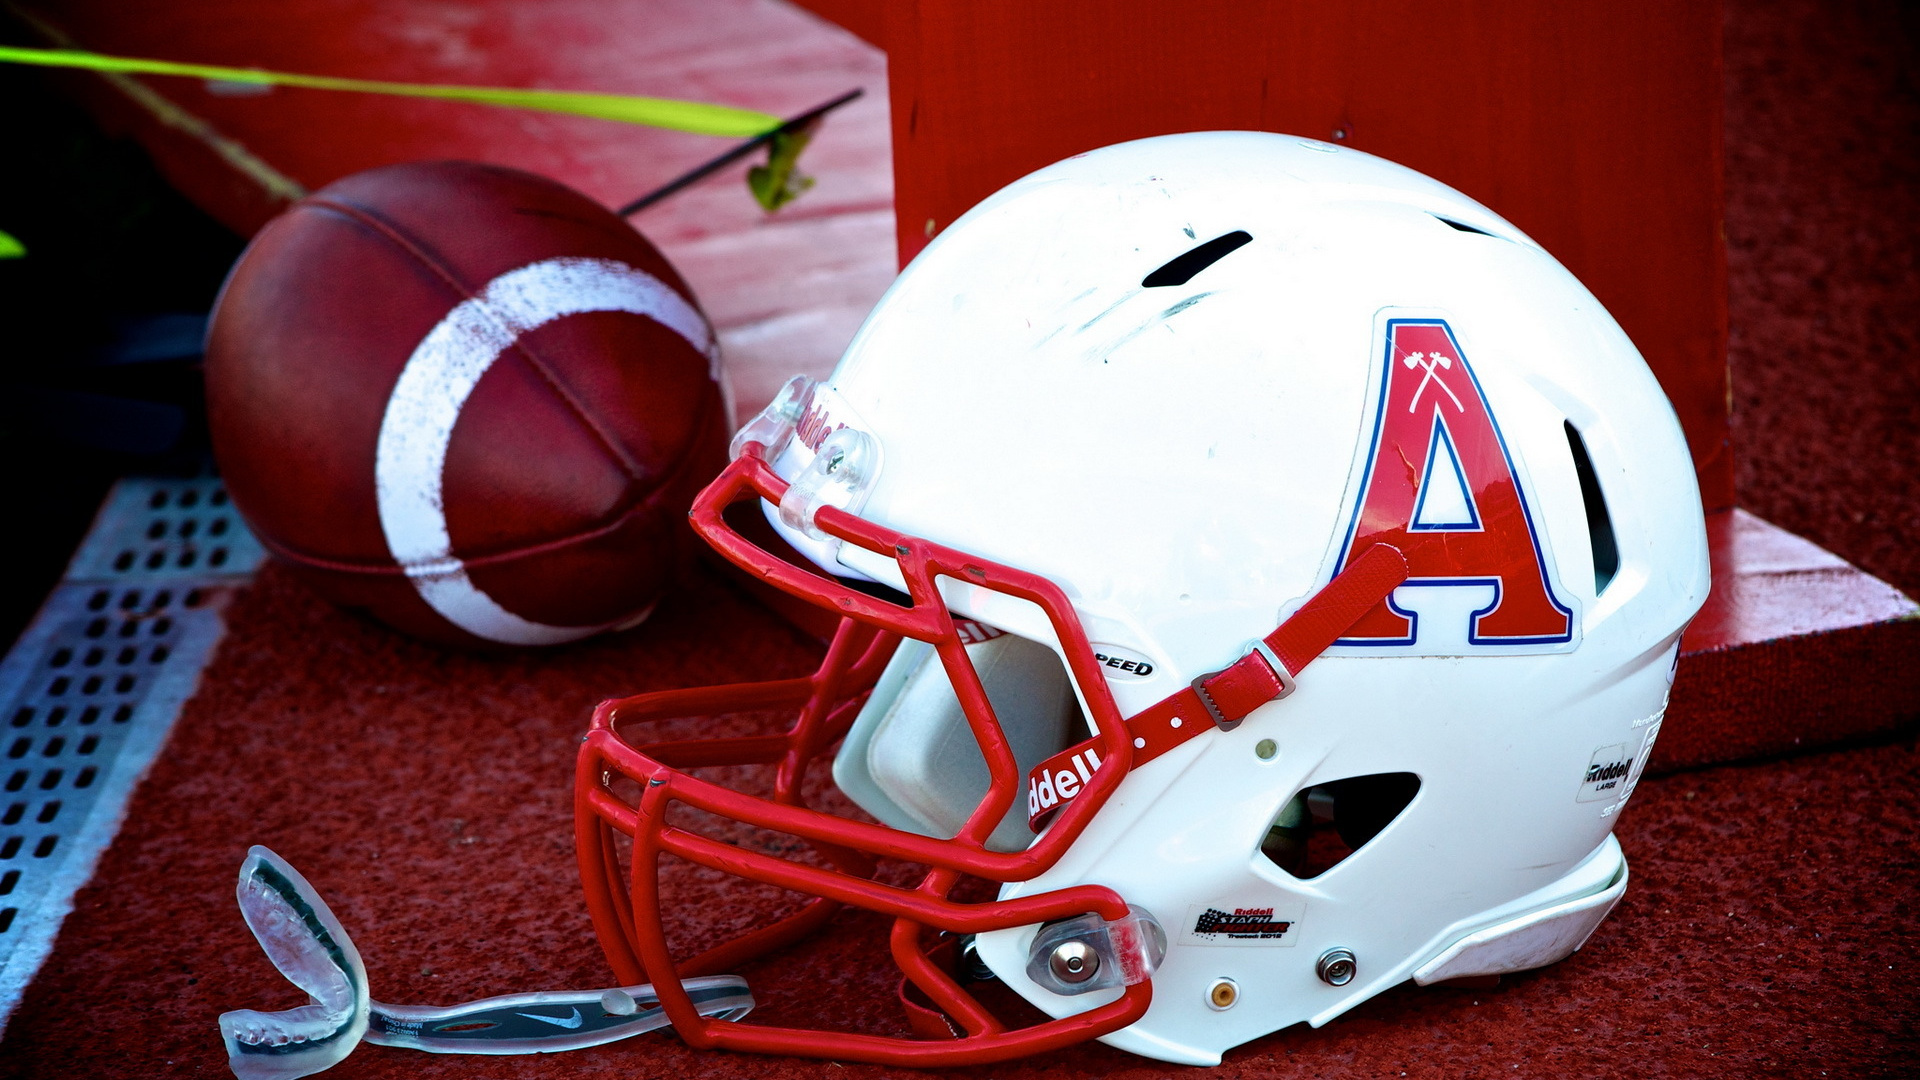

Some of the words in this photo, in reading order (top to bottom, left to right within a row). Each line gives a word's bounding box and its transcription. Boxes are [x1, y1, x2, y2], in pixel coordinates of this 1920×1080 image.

[1300, 318, 1573, 645] A
[1028, 748, 1102, 816] ddell
[1586, 758, 1634, 783] Riddell
[1595, 781, 1617, 791] LARGE
[1234, 908, 1274, 916] Riddell
